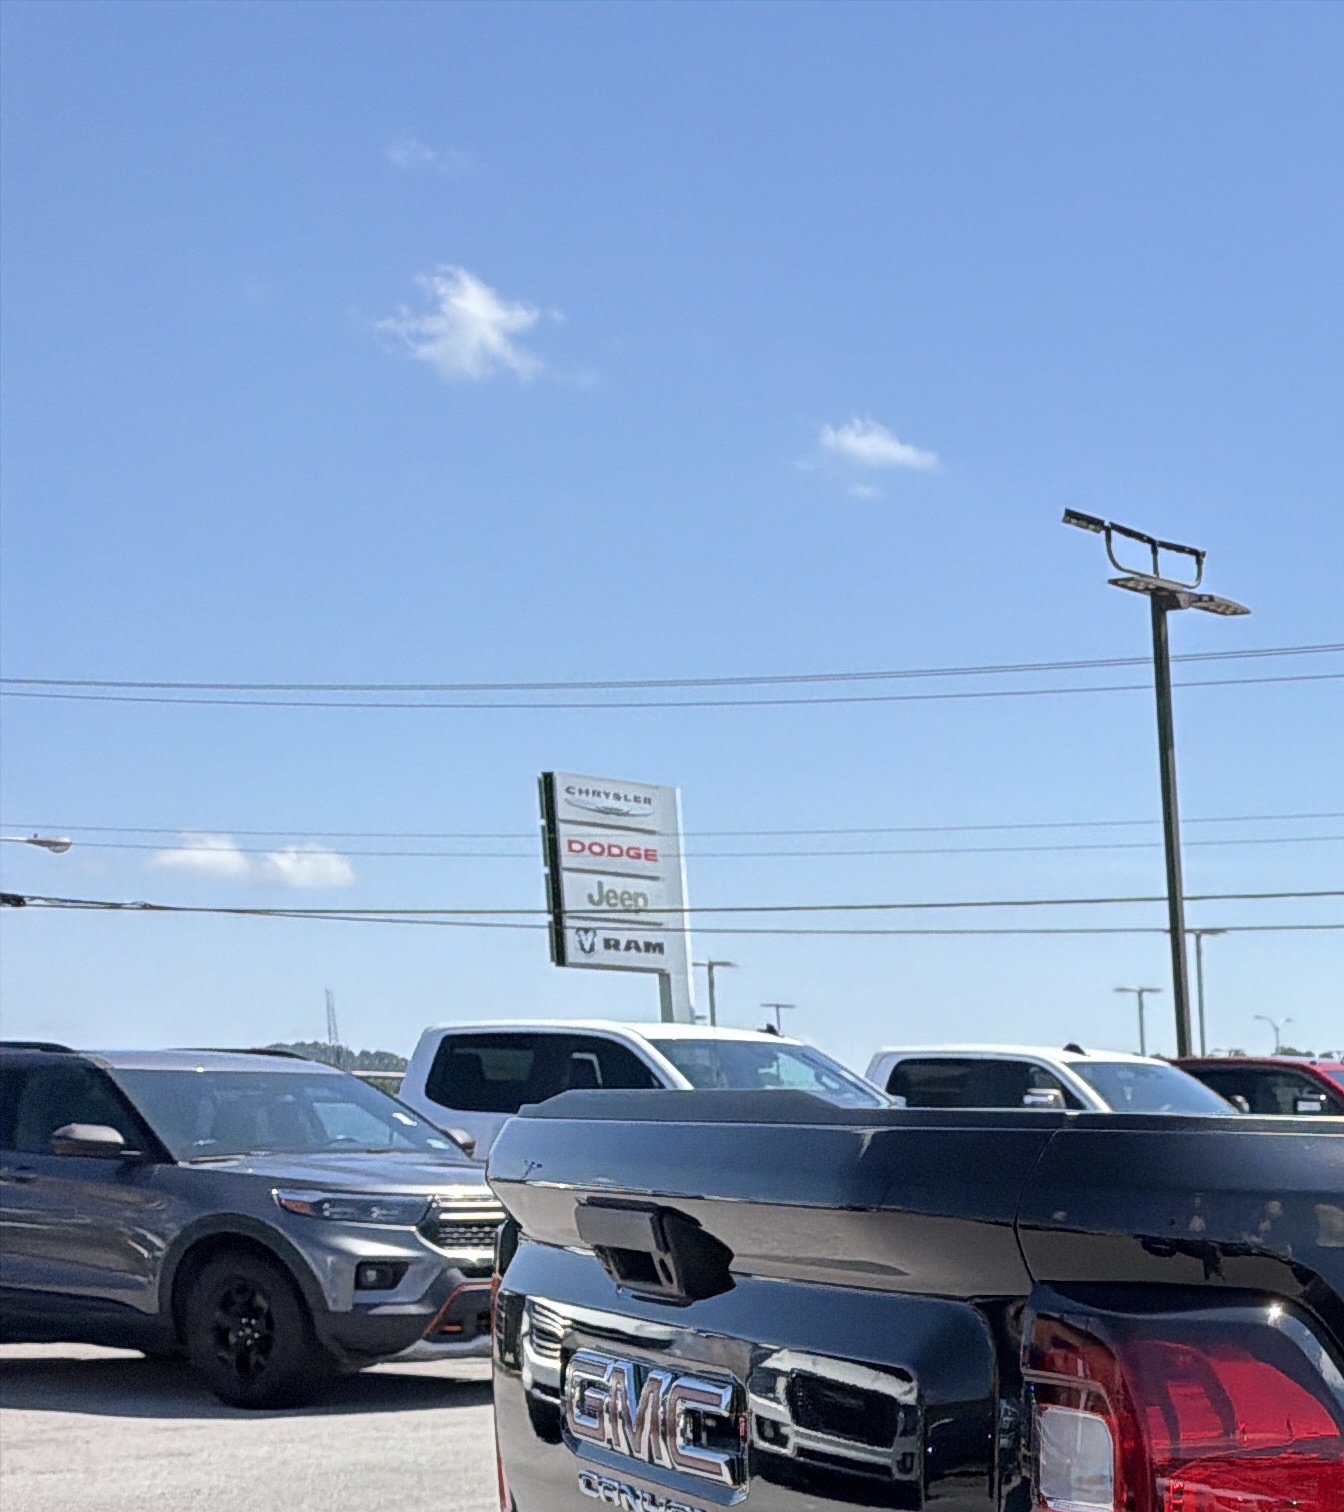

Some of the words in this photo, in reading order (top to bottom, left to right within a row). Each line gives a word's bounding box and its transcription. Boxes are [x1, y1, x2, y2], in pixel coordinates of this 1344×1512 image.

[565, 786, 652, 805] CHRYSLER
[567, 839, 658, 862] DODGE
[587, 881, 649, 914] Jeep
[603, 937, 664, 954] RAM
[565, 1352, 735, 1486] GMC
